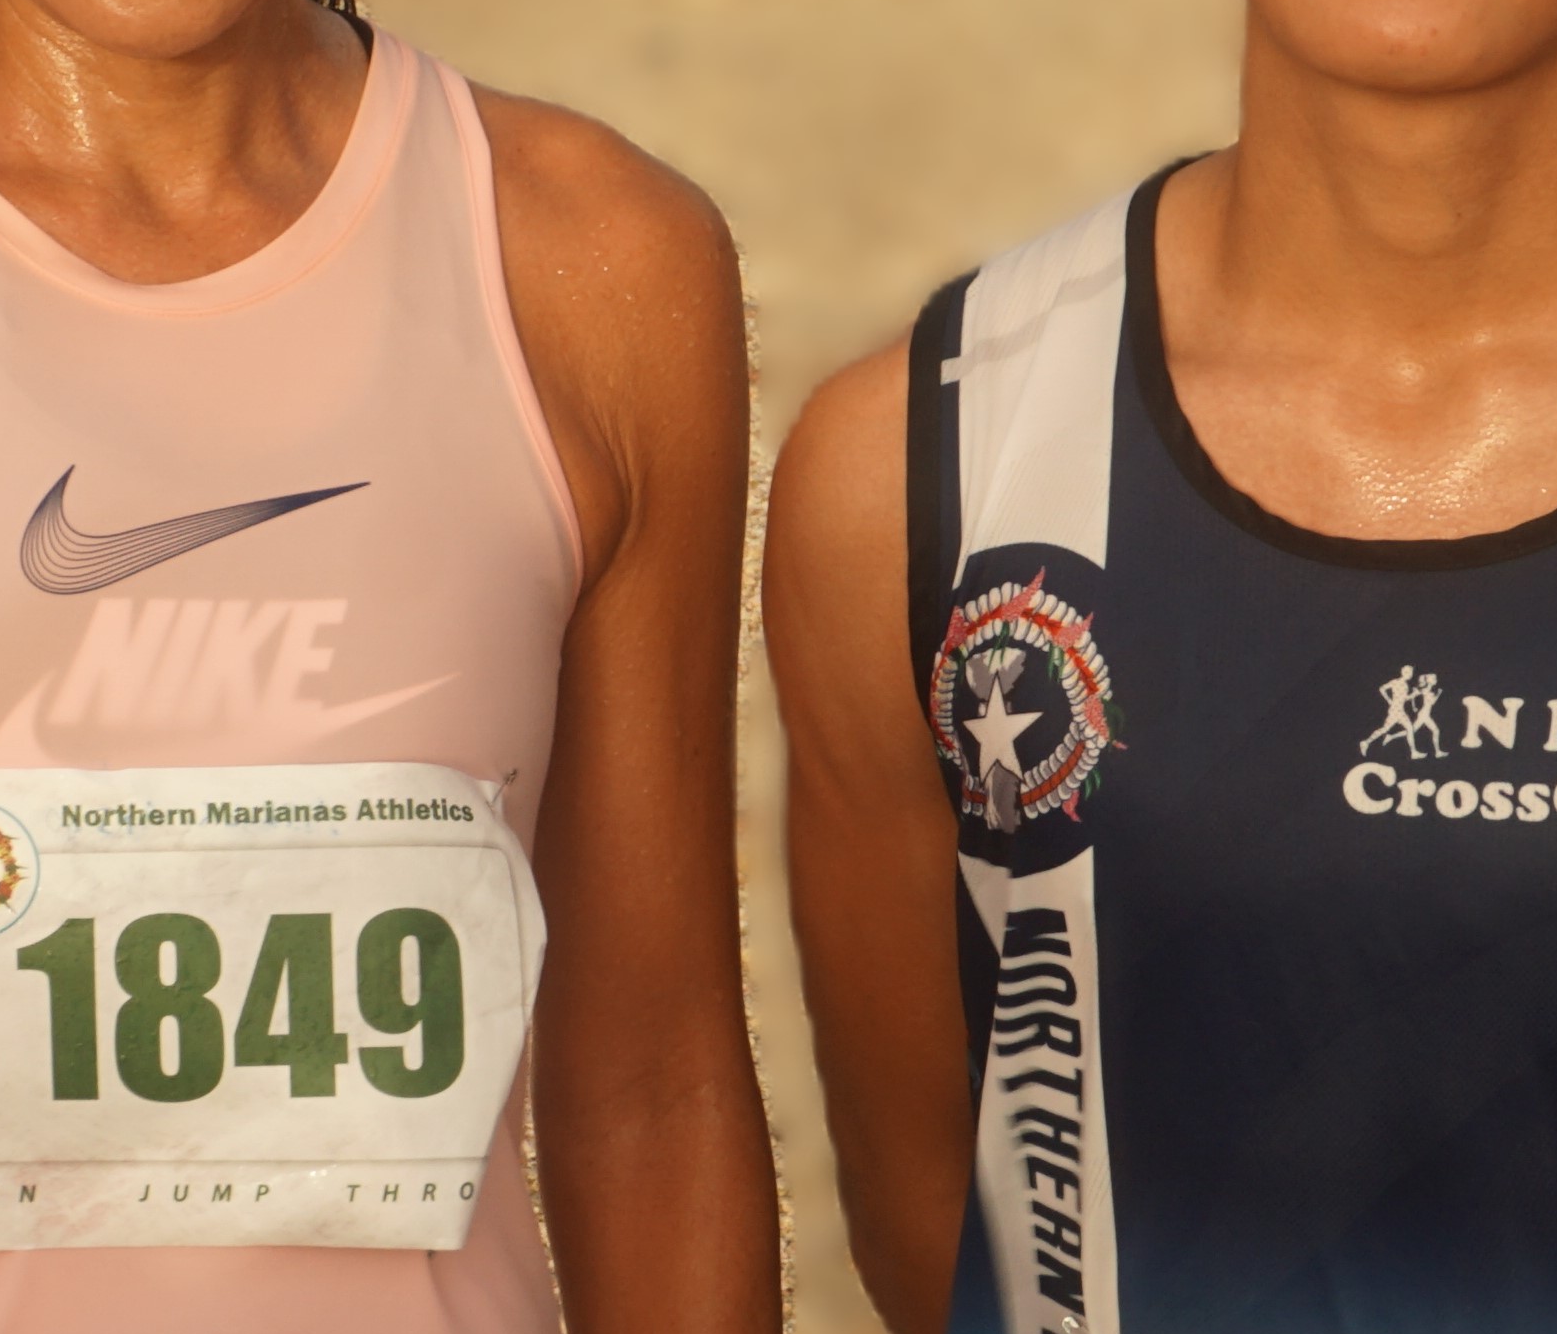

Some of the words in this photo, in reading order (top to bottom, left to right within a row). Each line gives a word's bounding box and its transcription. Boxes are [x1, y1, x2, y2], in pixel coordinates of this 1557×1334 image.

[46, 598, 349, 727] NIKE
[61, 804, 196, 828] Northern
[207, 801, 347, 826] Marianas
[356, 798, 475, 823] Athletics
[16, 907, 465, 1104] 1849
[993, 908, 1086, 1323] NORTHERN
[346, 1181, 475, 1203] THRO
